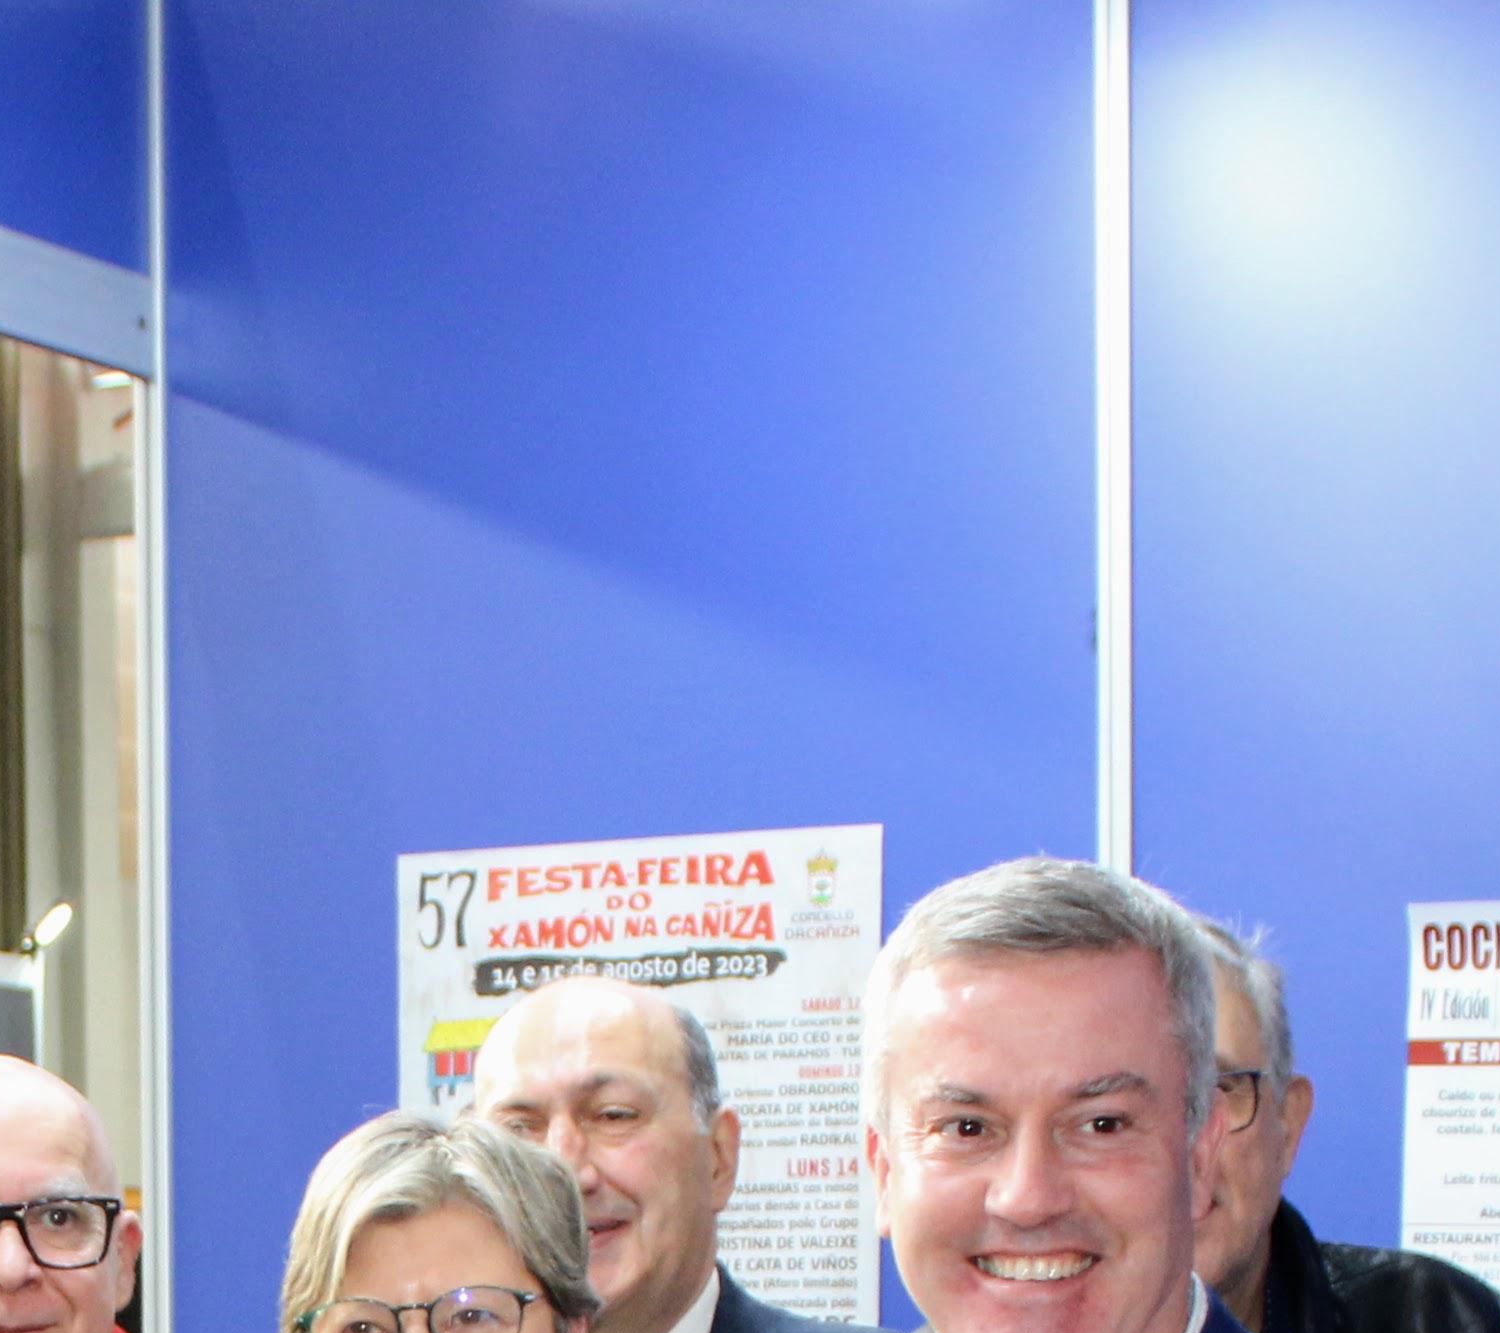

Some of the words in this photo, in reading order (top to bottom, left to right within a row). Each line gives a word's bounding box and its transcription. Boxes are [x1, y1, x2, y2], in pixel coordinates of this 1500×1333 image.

[486, 848, 776, 903] FESTA-FEIRA
[417, 868, 477, 950] 57
[606, 891, 652, 911] DO
[487, 909, 615, 950] XAMÓN
[624, 916, 660, 937] NA
[666, 899, 777, 942] CAÑIZA
[491, 964, 519, 990] 14
[522, 965, 536, 985] e
[601, 954, 679, 982] agosto
[681, 950, 710, 978] de
[715, 953, 768, 977] 2023
[1420, 986, 1436, 1022] IV
[1441, 985, 1491, 1022] Edición
[728, 1032, 774, 1047] MARÍA
[778, 1031, 799, 1045] DO
[802, 1031, 831, 1044] CEO
[716, 1051, 750, 1062] AITAS
[778, 1082, 860, 1097] OBRADOIRO
[785, 1102, 803, 1115] DE
[808, 1098, 860, 1115] XAMÓN
[800, 1132, 859, 1146] RADIKAL
[786, 1157, 831, 1178] LUNS
[838, 1156, 860, 1177] 14
[716, 1217, 786, 1232] mpañados
[788, 1217, 817, 1232] polo
[820, 1216, 859, 1231] Grupo
[716, 1236, 772, 1250] RISTINA
[776, 1235, 797, 1249] DE
[800, 1234, 858, 1248] VALEIXE
[746, 1257, 782, 1271] CATA
[787, 1257, 806, 1270] DE
[811, 1253, 858, 1270] VIÑOS
